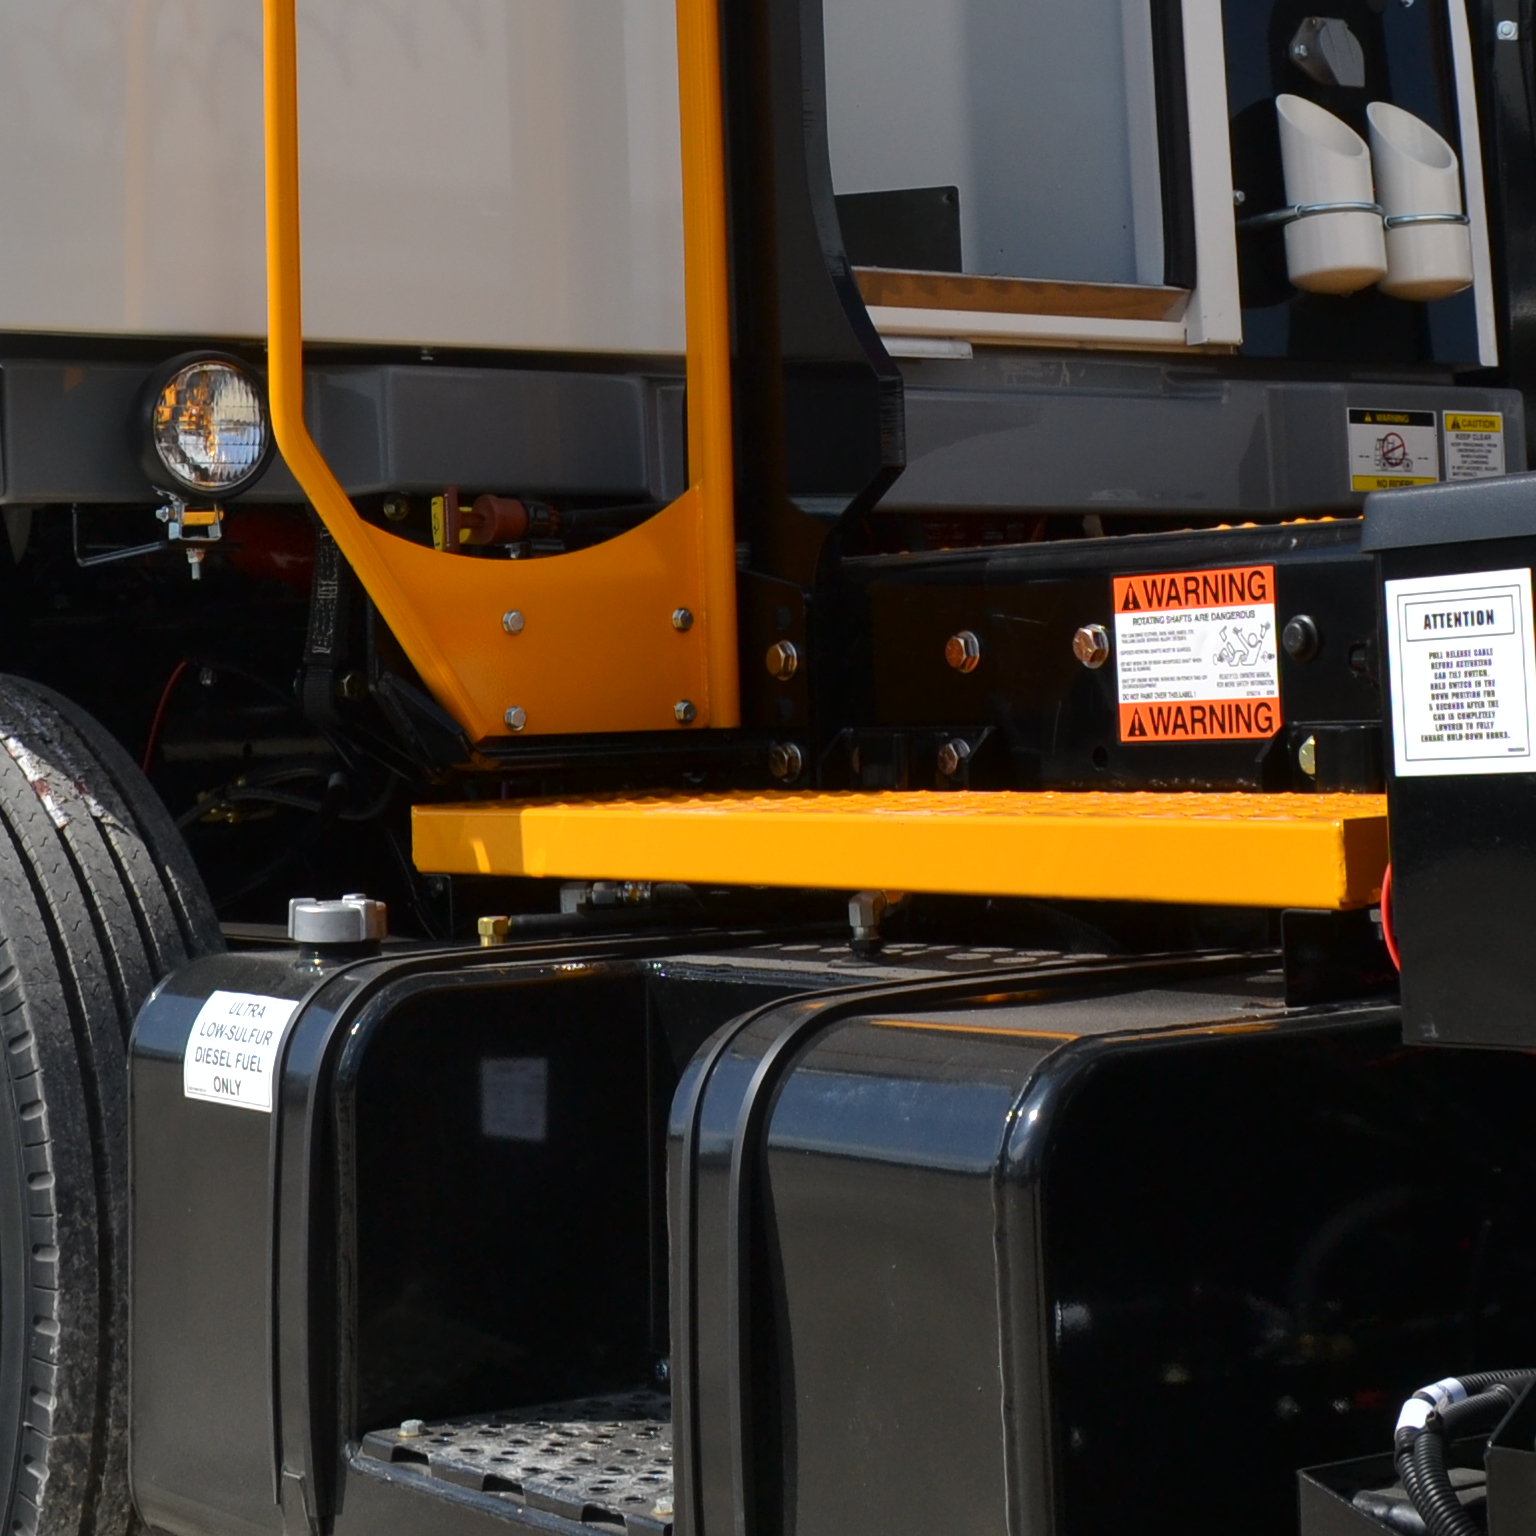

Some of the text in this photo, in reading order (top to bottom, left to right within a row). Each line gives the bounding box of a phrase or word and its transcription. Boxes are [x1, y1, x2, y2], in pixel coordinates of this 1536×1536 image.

[1376, 413, 1410, 423] WARNING
[1461, 418, 1496, 429] CAUTION
[1376, 479, 1388, 489] NO
[1142, 570, 1267, 608] WARNING
[1132, 610, 1256, 626] ROTATING SHAFTS ARE DANGEROUS
[1423, 609, 1495, 630] ATTENTION
[1149, 702, 1274, 736] WARNING
[229, 1001, 267, 1019] ULTRA
[199, 1022, 273, 1046] LOW-SULFUR
[195, 1046, 263, 1073] DIESEL FUEL
[213, 1076, 242, 1096] ONLY
